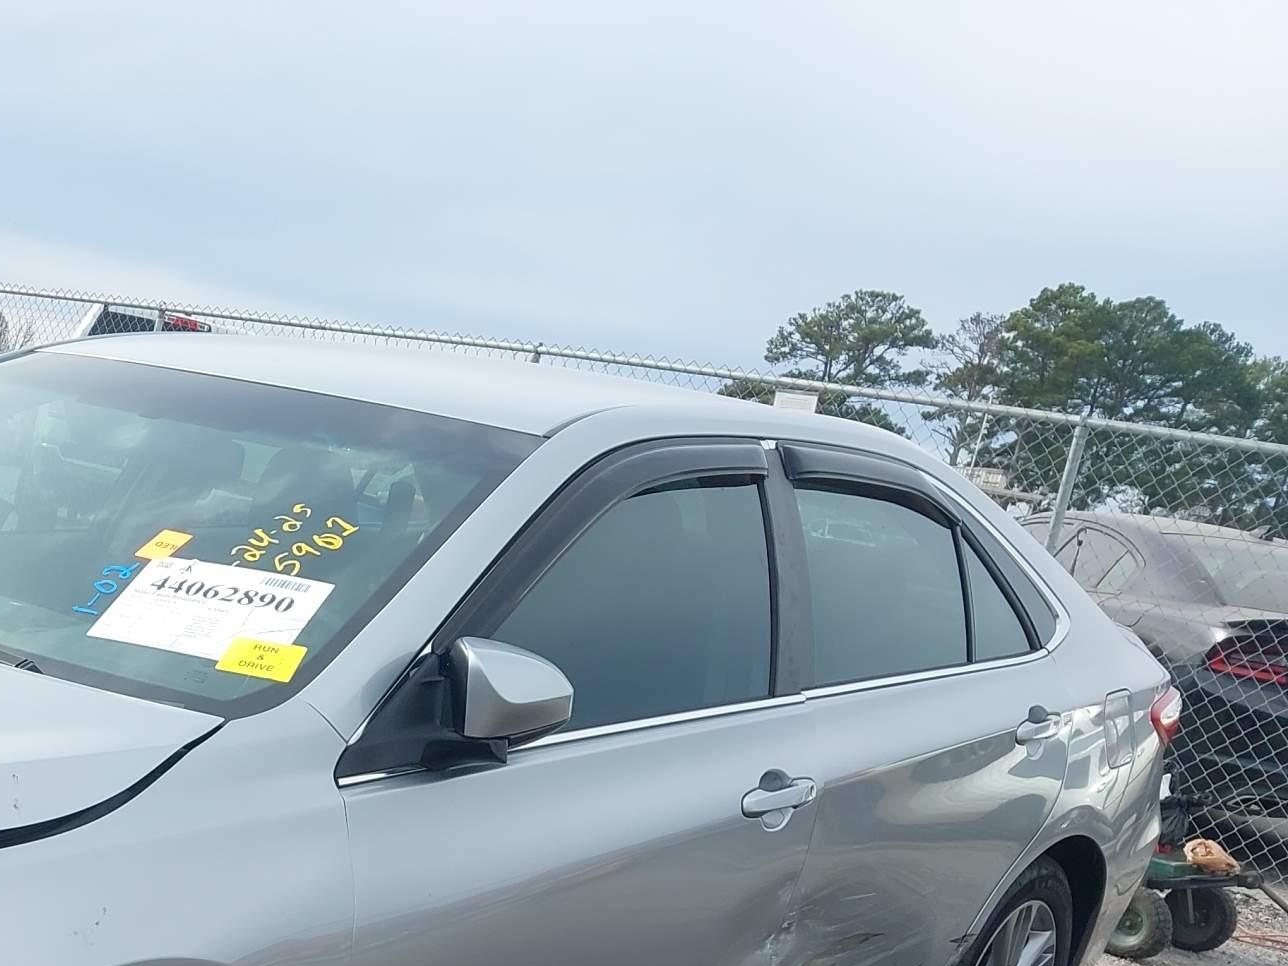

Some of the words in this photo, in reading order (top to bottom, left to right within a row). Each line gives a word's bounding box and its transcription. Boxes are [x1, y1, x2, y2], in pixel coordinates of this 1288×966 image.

[150, 574, 295, 613] 44062890
[252, 643, 280, 655] RUN
[238, 660, 275, 672] DRIVE
